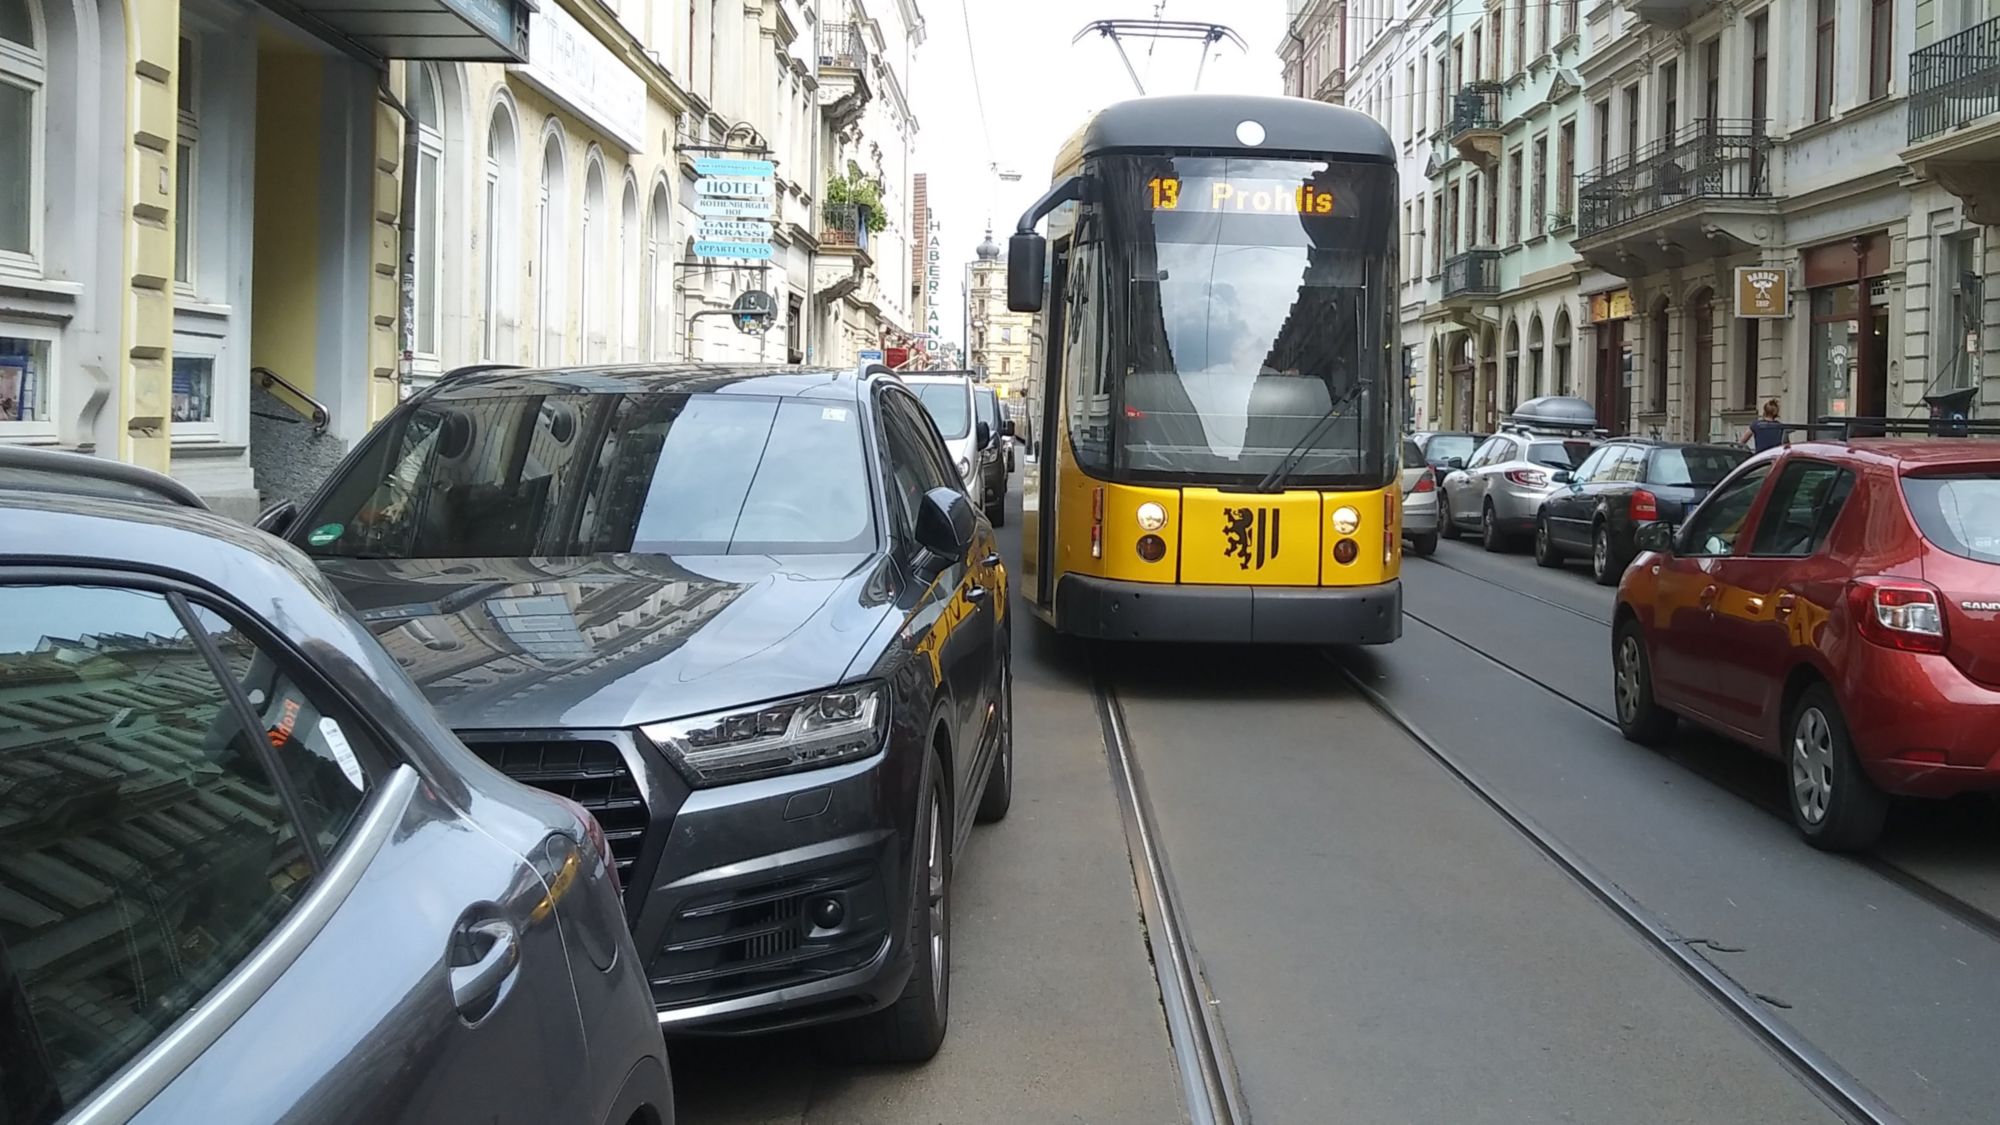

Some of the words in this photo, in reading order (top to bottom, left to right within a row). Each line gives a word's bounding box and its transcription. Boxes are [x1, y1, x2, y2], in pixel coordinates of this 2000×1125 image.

[707, 181, 764, 195] HOTEL
[1148, 178, 1179, 210] 13
[1212, 182, 1334, 213] Prohlis
[700, 200, 769, 209] ROTHENBURGER
[699, 228, 768, 237] TERRASSE
[697, 245, 769, 254] APPARTEMENTS
[1747, 272, 1779, 283] BARBER
[927, 221, 940, 351] HABERLAND
